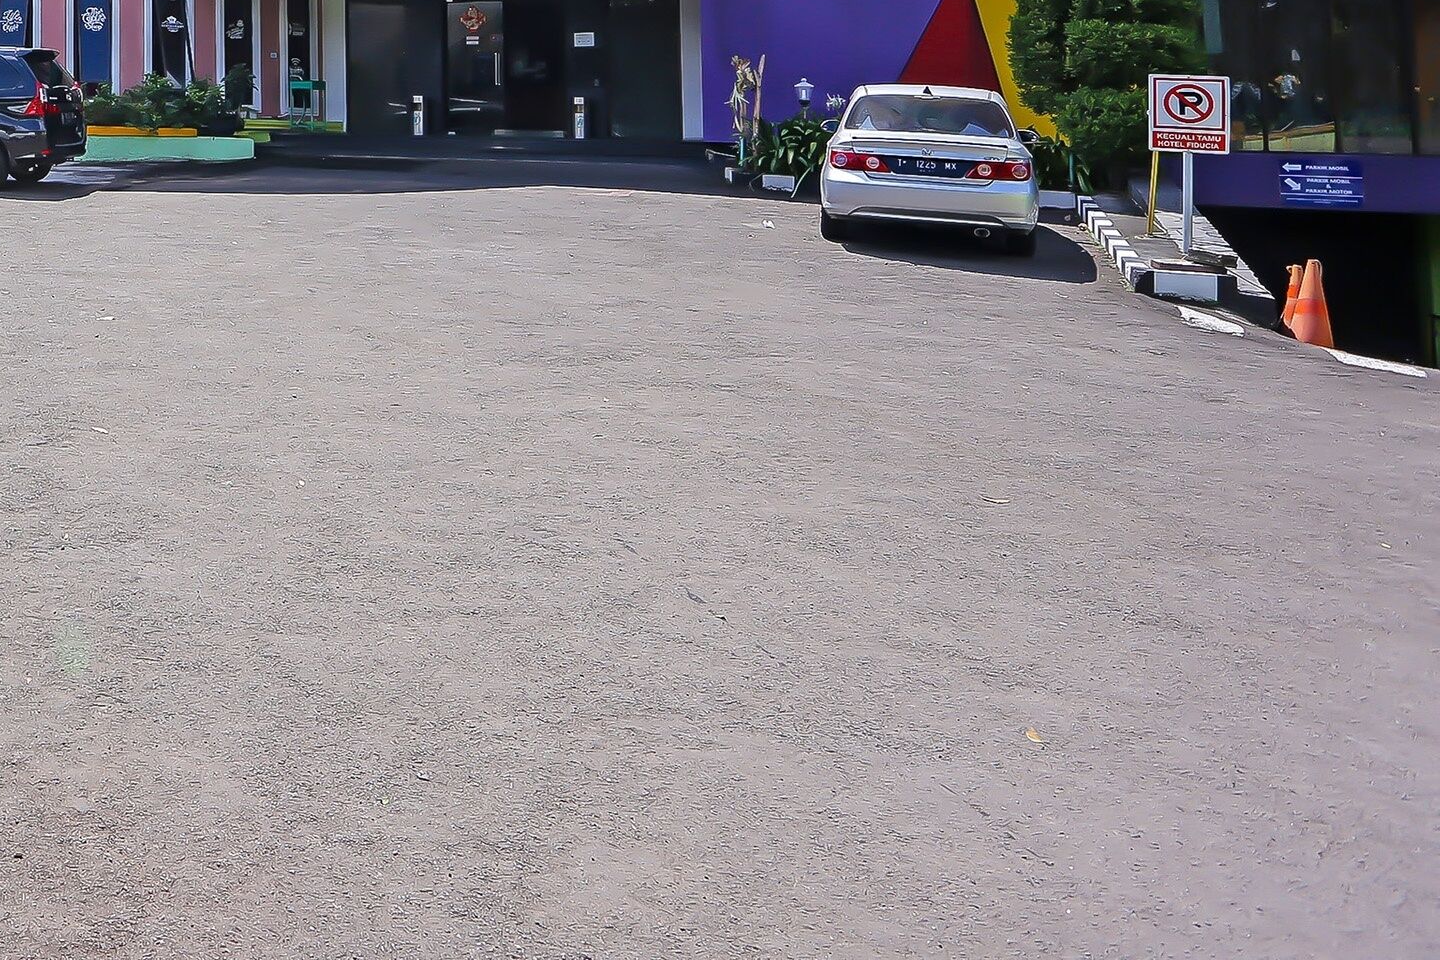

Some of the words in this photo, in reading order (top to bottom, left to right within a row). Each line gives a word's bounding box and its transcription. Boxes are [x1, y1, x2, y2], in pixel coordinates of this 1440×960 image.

[1178, 92, 1203, 115] P
[1156, 133, 1195, 141] KECUALI
[1157, 140, 1186, 148] HOTEL
[1187, 141, 1219, 149] FIDUCIA
[915, 159, 937, 169] 1225
[944, 162, 957, 170] MX
